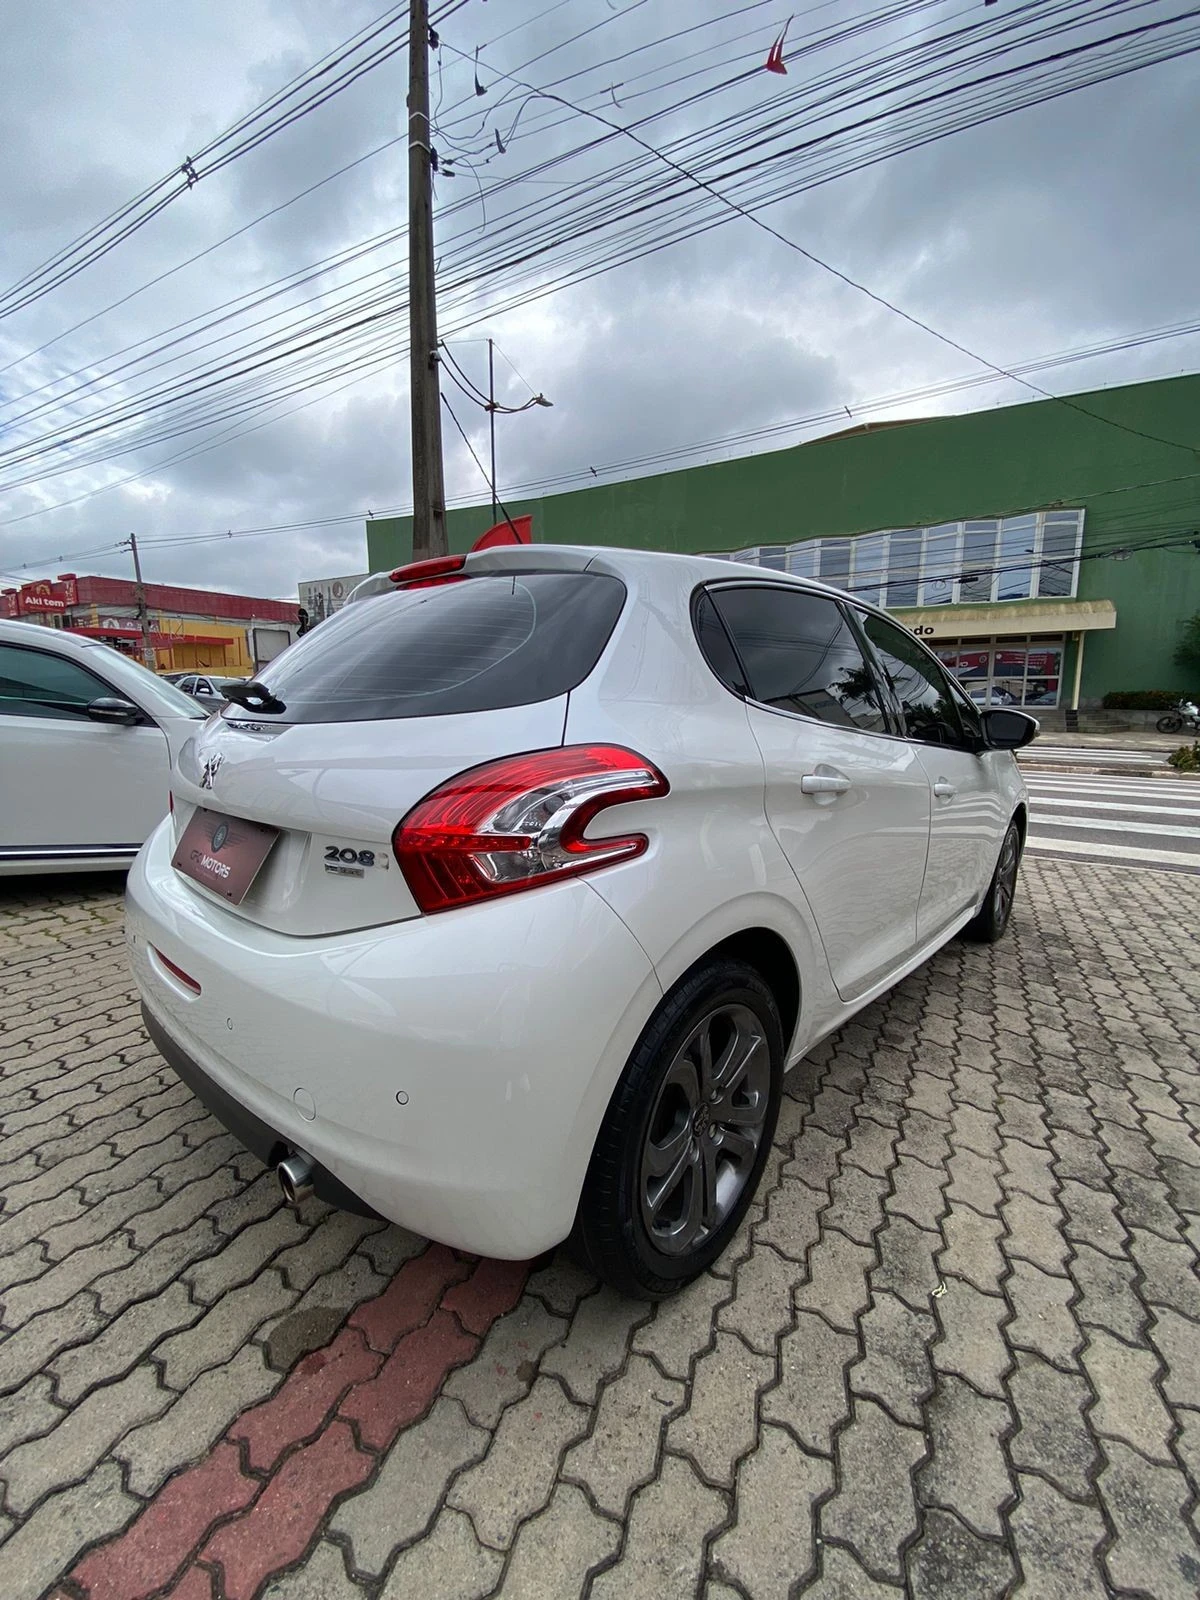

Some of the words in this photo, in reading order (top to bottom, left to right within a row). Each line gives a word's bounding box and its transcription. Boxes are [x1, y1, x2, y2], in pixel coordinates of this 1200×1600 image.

[909, 625, 934, 635] do
[200, 854, 231, 878] MOTORS
[324, 845, 375, 867] 208
